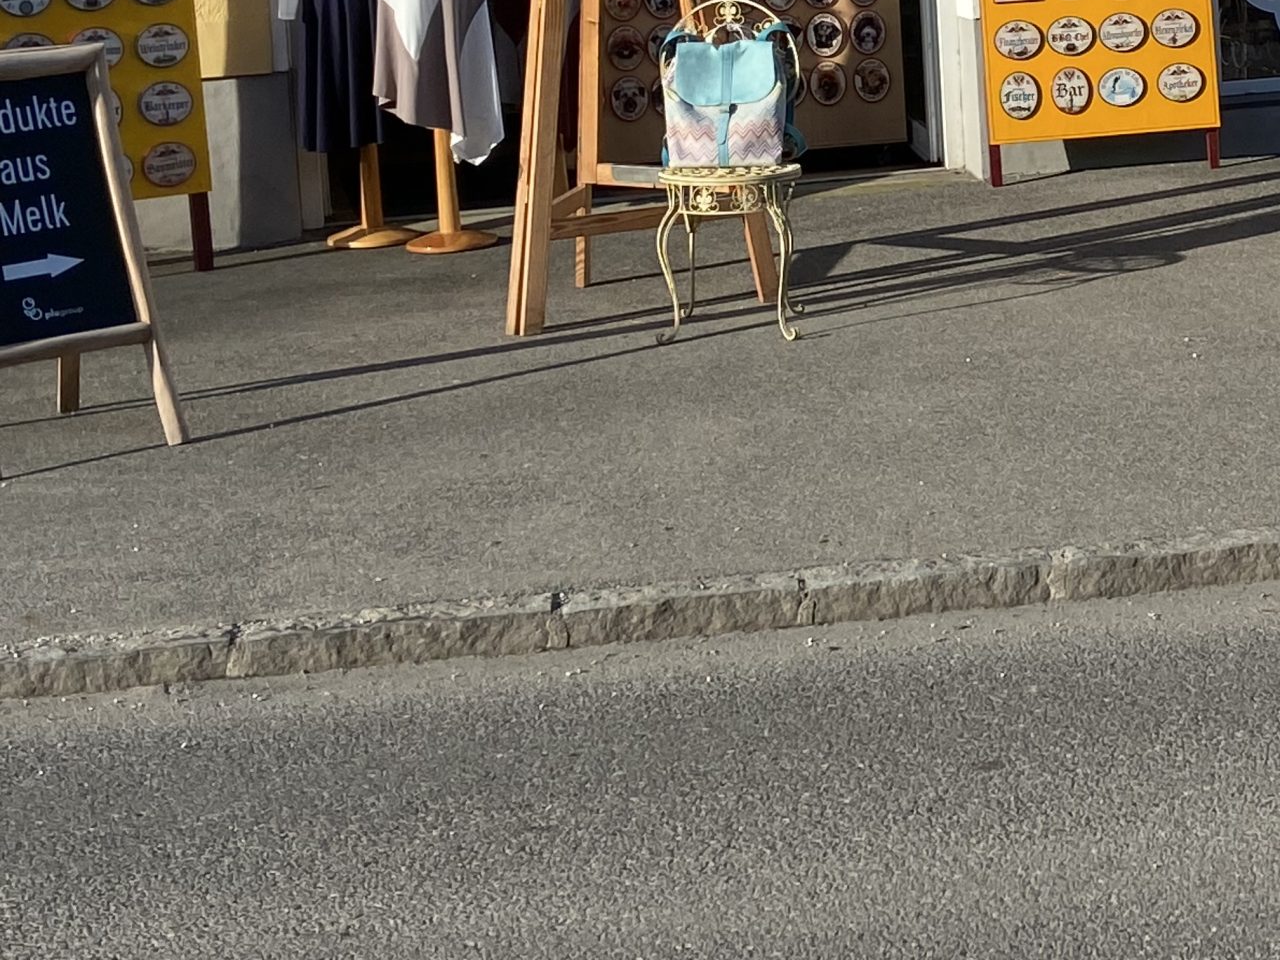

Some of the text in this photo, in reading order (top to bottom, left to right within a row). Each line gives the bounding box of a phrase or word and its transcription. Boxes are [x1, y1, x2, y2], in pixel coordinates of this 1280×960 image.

[1003, 90, 1036, 104] Fischer
[1056, 82, 1085, 98] Bar
[0, 153, 51, 186] aus
[0, 193, 71, 237] Melk
